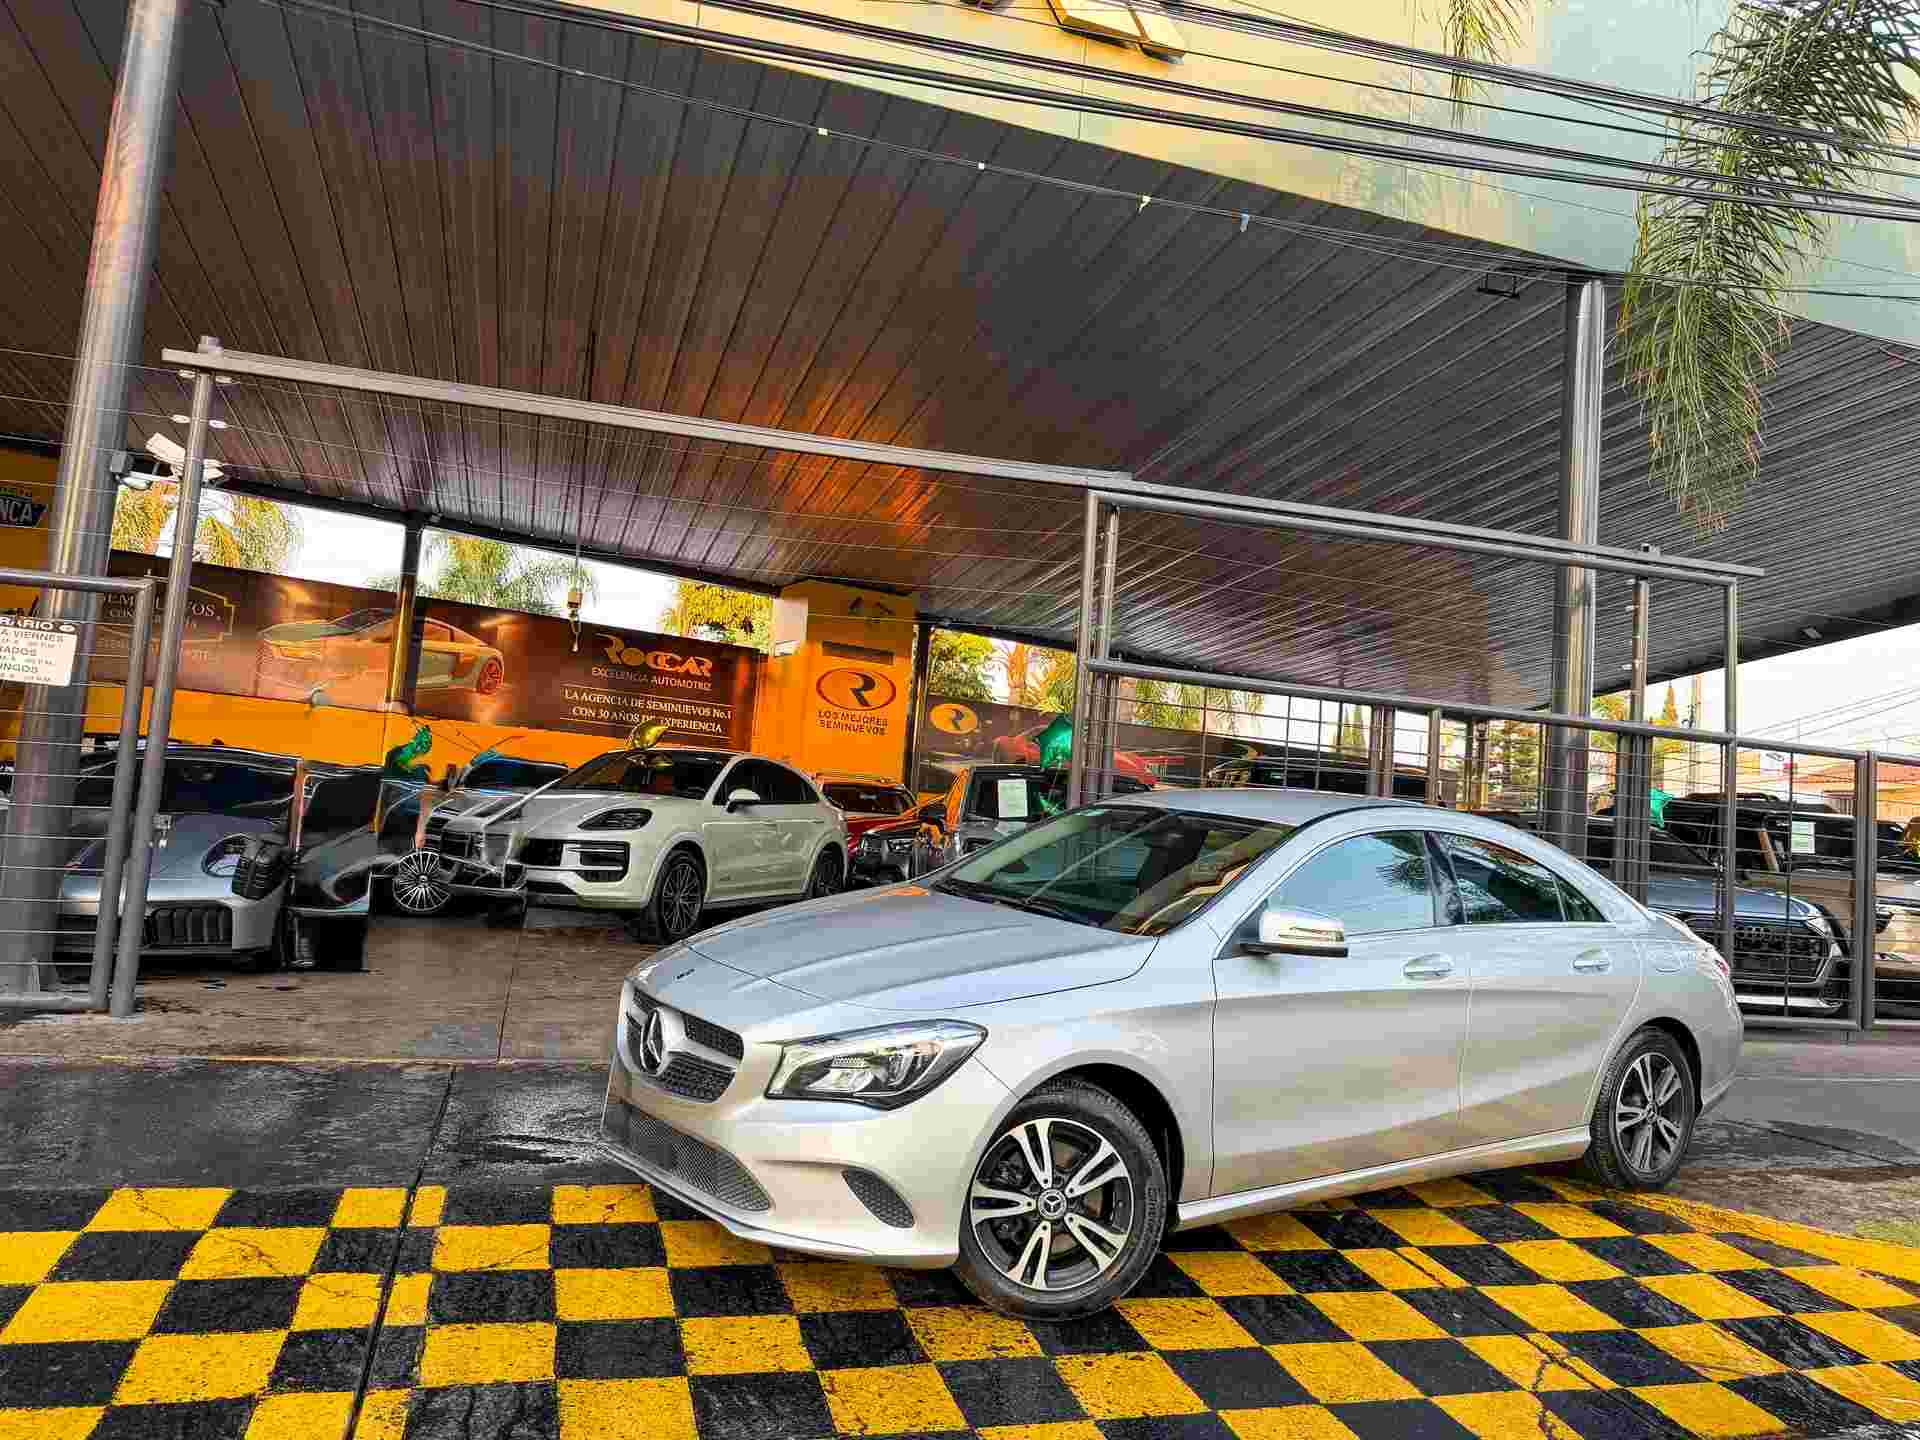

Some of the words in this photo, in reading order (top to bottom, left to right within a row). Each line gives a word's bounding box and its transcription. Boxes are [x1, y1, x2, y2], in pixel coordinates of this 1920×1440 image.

[14, 630, 64, 643] VIERNES
[591, 665, 648, 682] EXCELENCIA
[652, 675, 713, 690] AUTOMOTRIZ
[565, 688, 578, 701] LA
[580, 692, 629, 706] AGENCIA
[631, 697, 643, 708] DE
[646, 700, 711, 717] SEMINUEVOS
[572, 706, 596, 718] CON
[599, 708, 610, 719] 30
[817, 710, 838, 720] LOS
[840, 711, 888, 727] MEJORES
[818, 719, 886, 736] SEMINUEVOS
